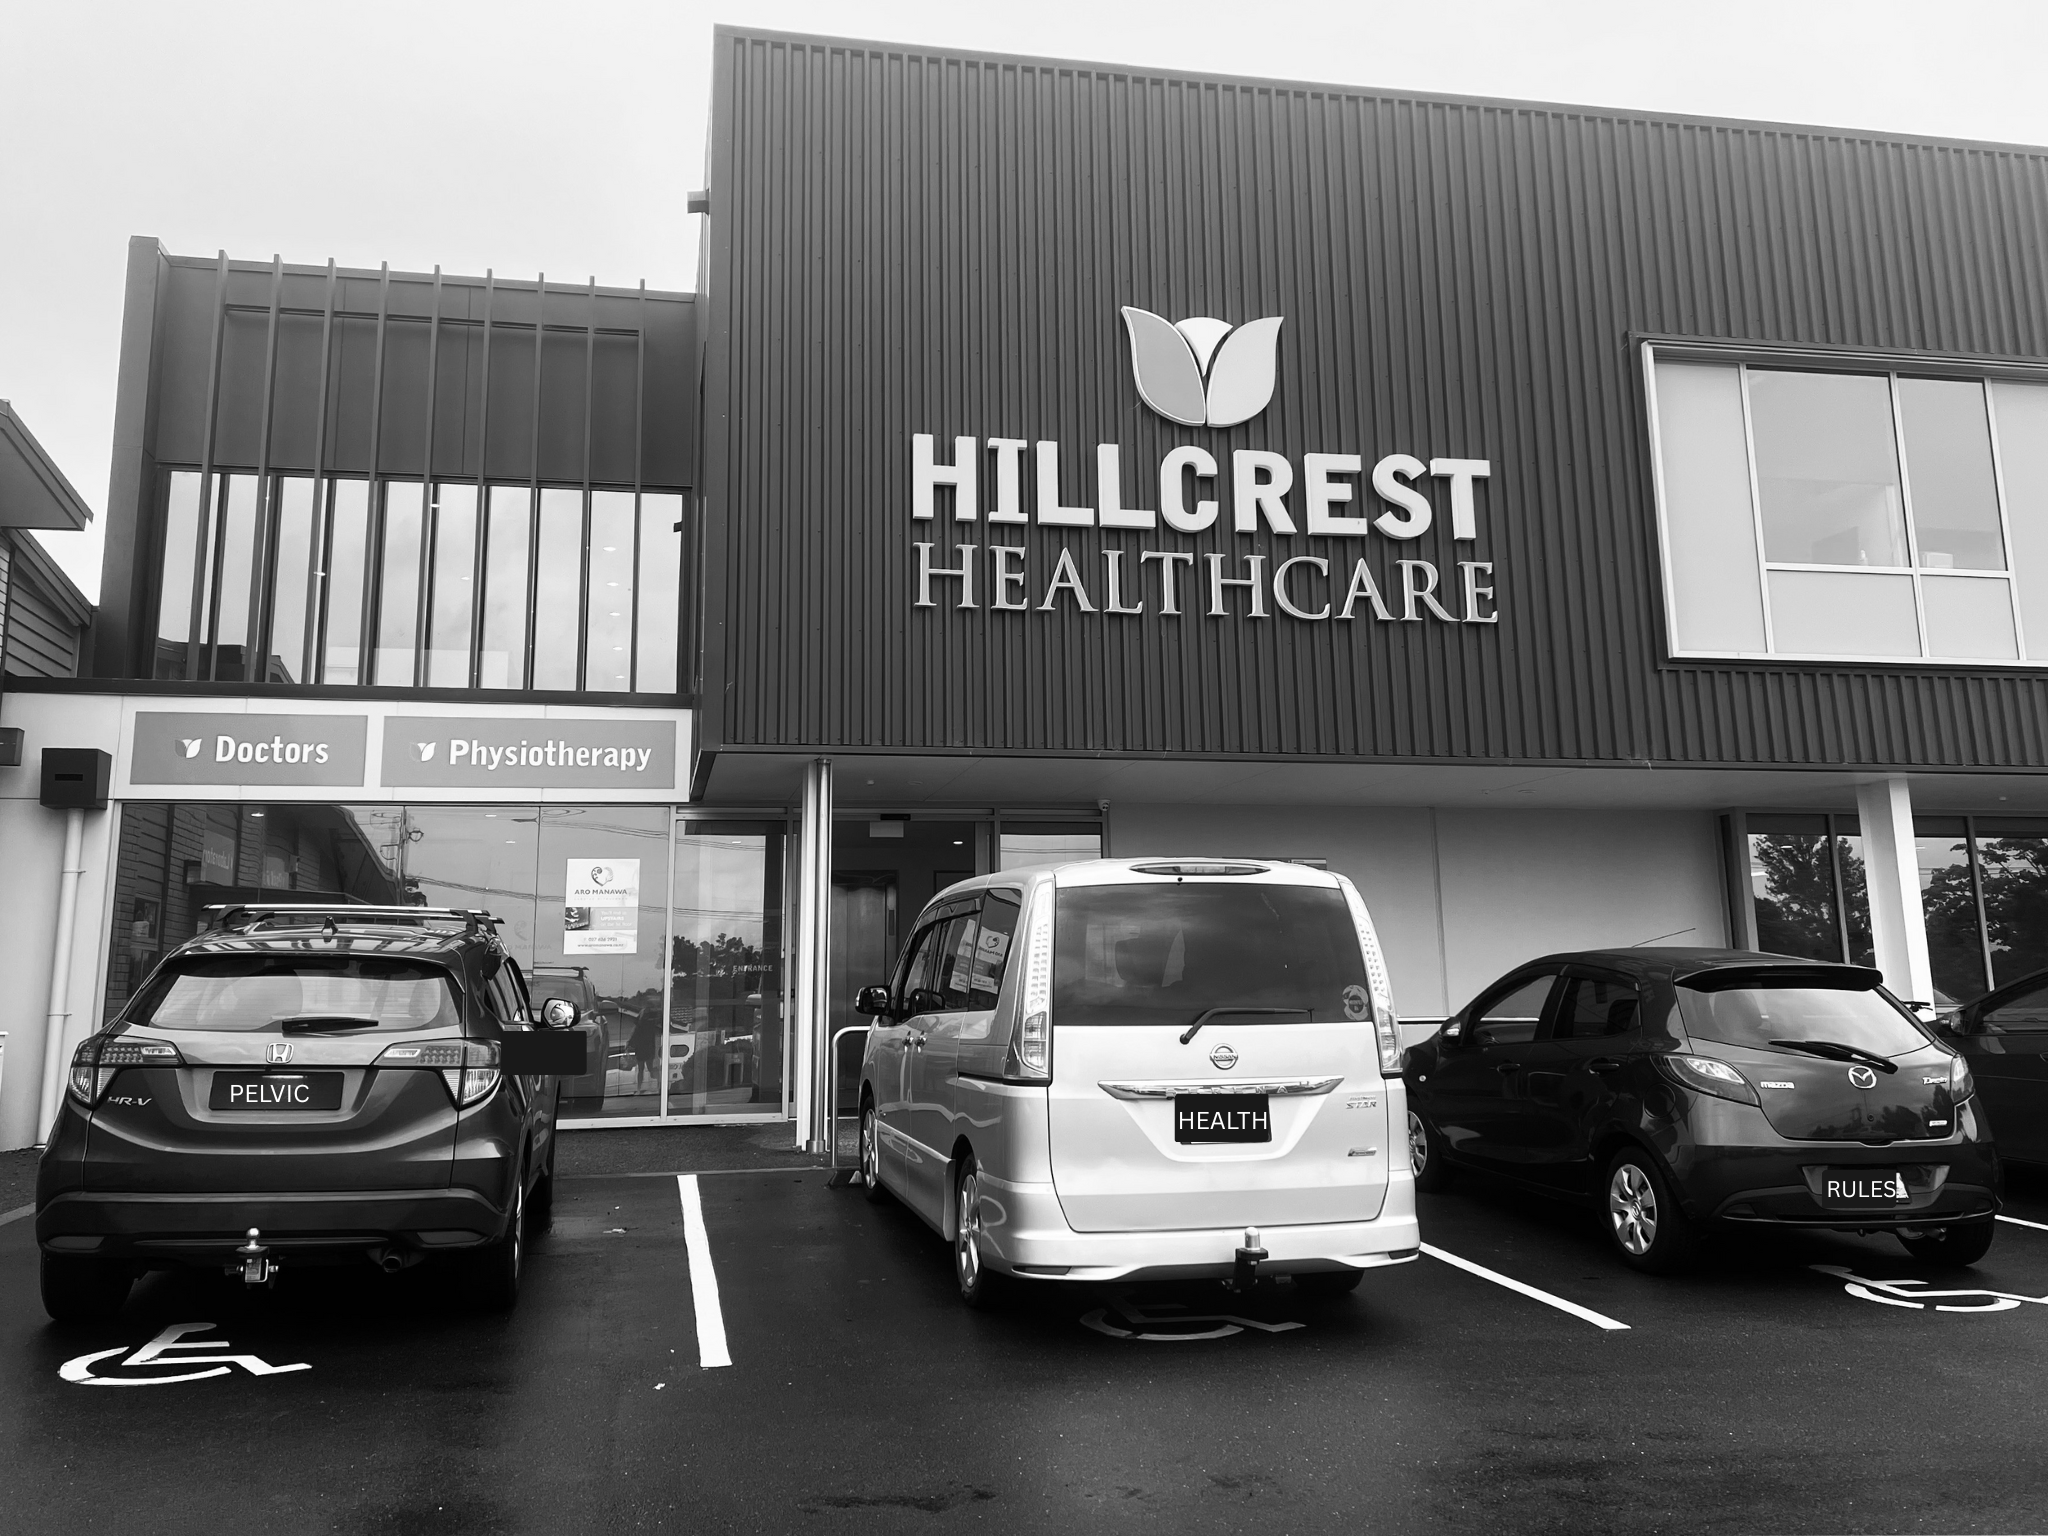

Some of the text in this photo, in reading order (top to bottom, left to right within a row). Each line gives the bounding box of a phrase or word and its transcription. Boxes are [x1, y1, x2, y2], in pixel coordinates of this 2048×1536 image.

[912, 433, 1491, 541] HILLCREST
[912, 542, 1499, 624] HEALTHCARE
[214, 735, 329, 764] Doctors
[449, 739, 652, 771] Physiotherapy
[732, 964, 773, 972] ENTRANCE
[107, 1096, 152, 1106] HR-V
